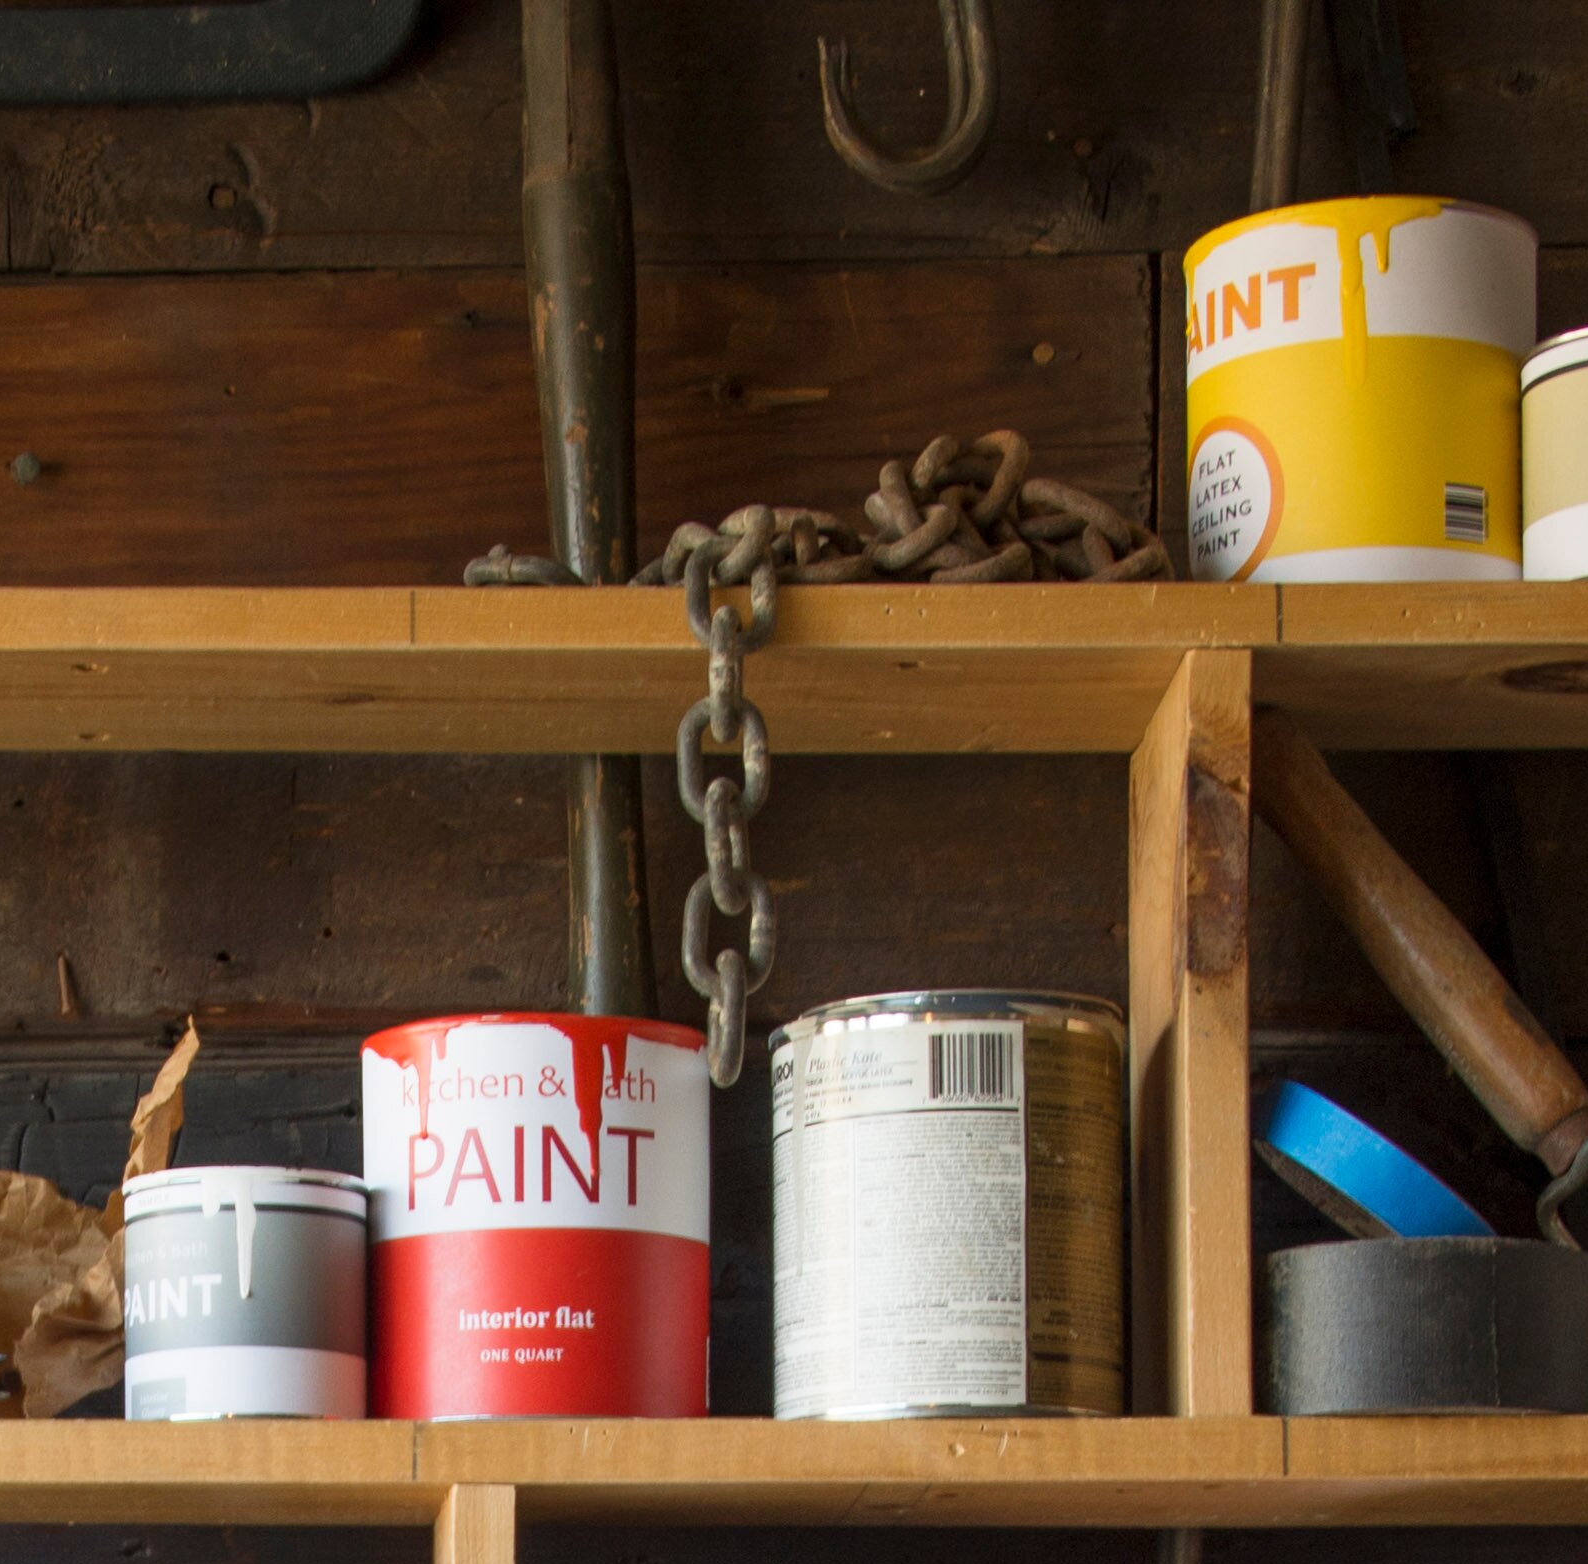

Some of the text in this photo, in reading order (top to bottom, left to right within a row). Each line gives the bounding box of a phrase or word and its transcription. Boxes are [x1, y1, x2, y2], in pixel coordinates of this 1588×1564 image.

[1198, 450, 1235, 480] FLAT
[1196, 475, 1241, 510] LATEX
[1192, 500, 1252, 539] CEILING
[1197, 529, 1240, 561] PAINT
[403, 1065, 656, 1106] kchen & ath
[408, 1124, 655, 1211] PAINT
[459, 1301, 595, 1331] interior flat
[480, 1348, 564, 1364] ONE QUART
